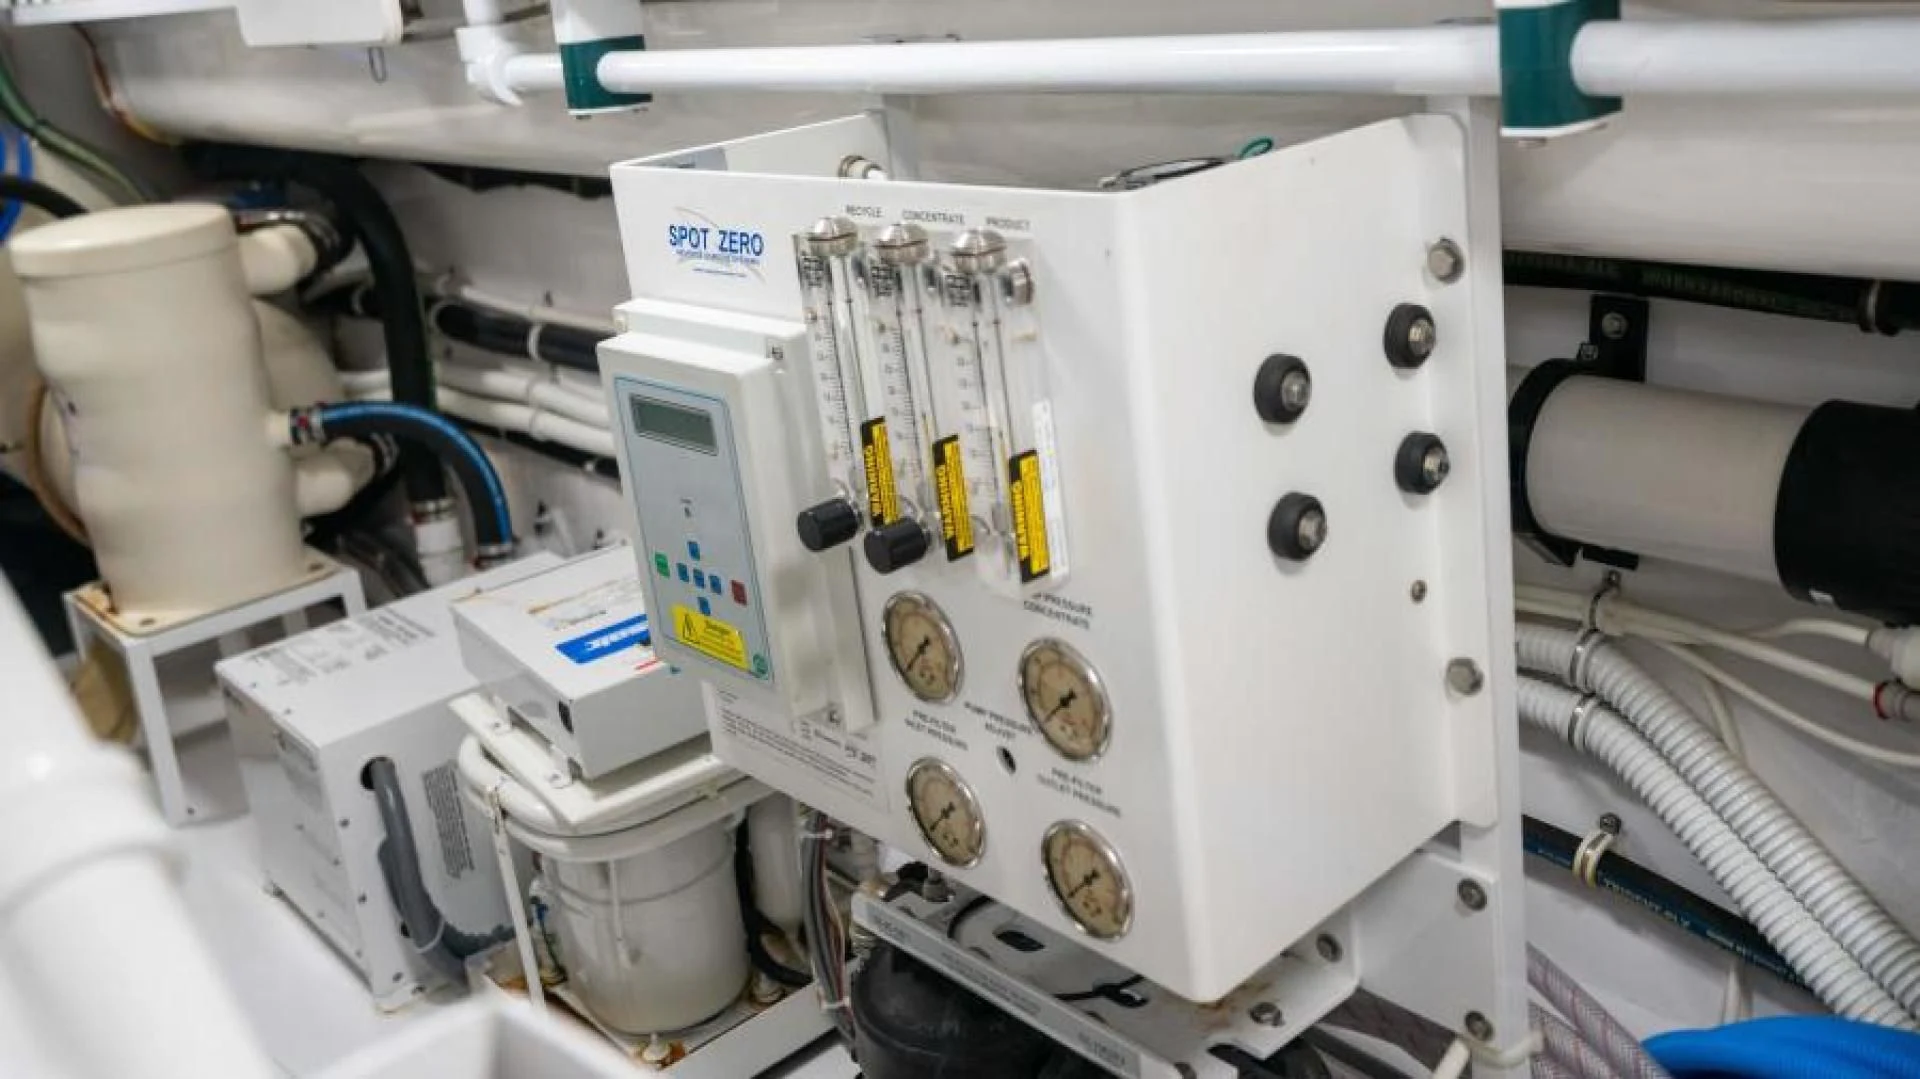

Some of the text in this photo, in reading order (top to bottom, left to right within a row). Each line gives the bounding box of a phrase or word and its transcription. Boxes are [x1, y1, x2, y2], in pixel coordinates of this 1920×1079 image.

[846, 204, 883, 219] RECYCLE
[902, 209, 965, 225] CONCENTRATE
[985, 216, 1031, 231] PRODUCT
[669, 223, 708, 250] SPOT
[718, 229, 765, 257] ZERO
[863, 445, 882, 517] WARNING
[935, 465, 955, 539] WARNING
[1011, 480, 1030, 560] WARNING
